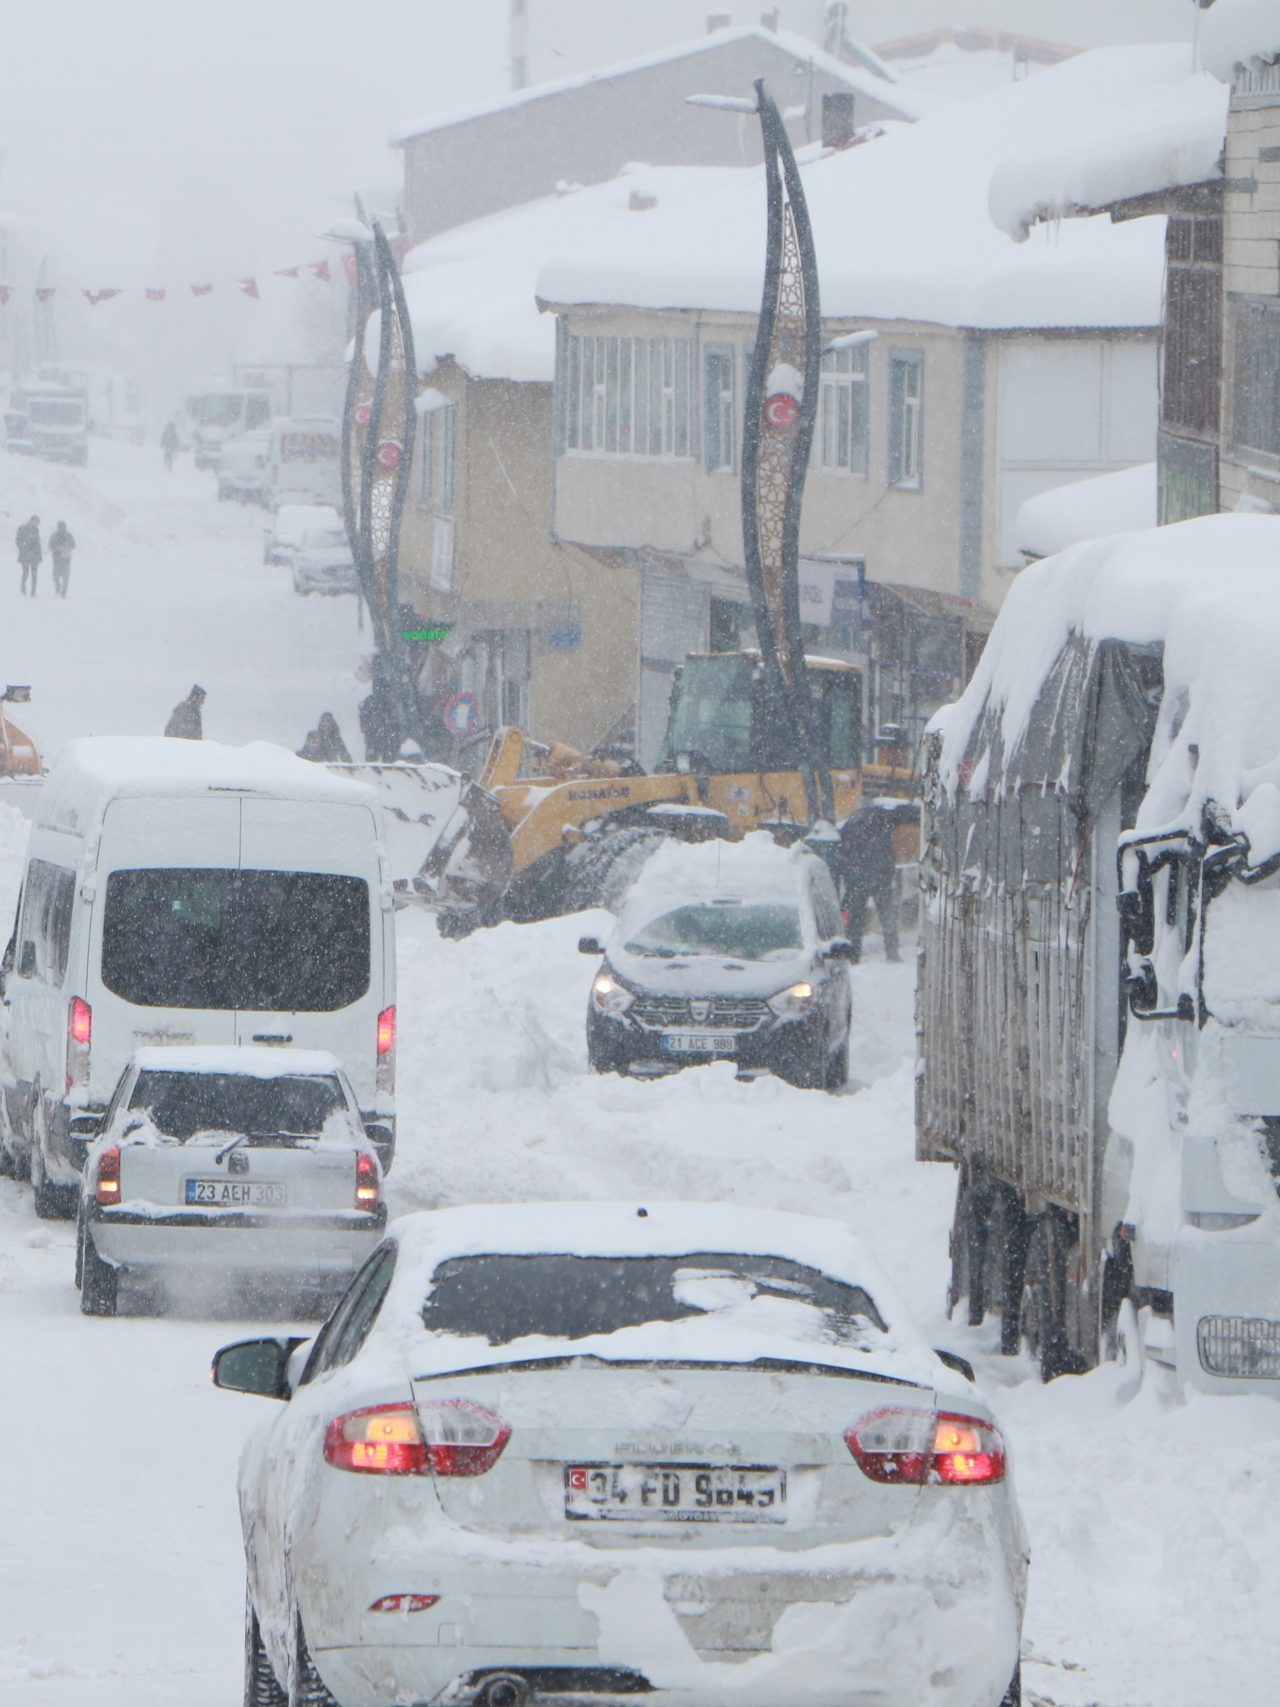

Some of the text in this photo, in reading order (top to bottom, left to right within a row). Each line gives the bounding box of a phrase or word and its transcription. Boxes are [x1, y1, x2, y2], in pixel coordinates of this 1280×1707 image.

[670, 1037, 682, 1049] 21
[688, 1038, 707, 1050] ACE
[197, 1184, 216, 1201] 23
[255, 1186, 284, 1203] 303
